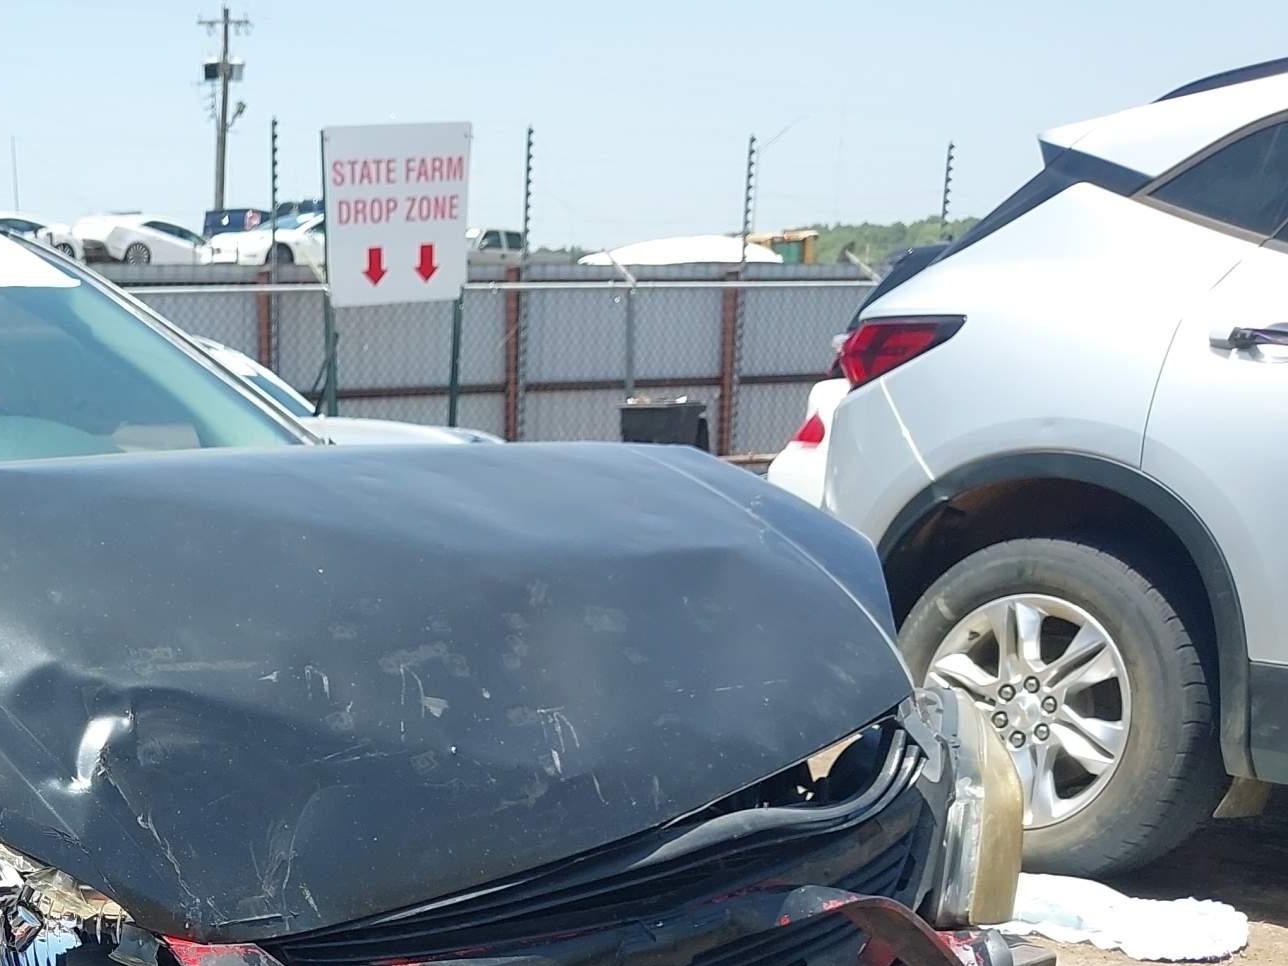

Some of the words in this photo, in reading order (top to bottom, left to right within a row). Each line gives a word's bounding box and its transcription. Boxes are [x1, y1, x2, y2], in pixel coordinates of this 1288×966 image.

[331, 158, 397, 186] STATE
[404, 156, 465, 182] FARM
[337, 198, 398, 225] DROP
[405, 194, 460, 222] ZONE
